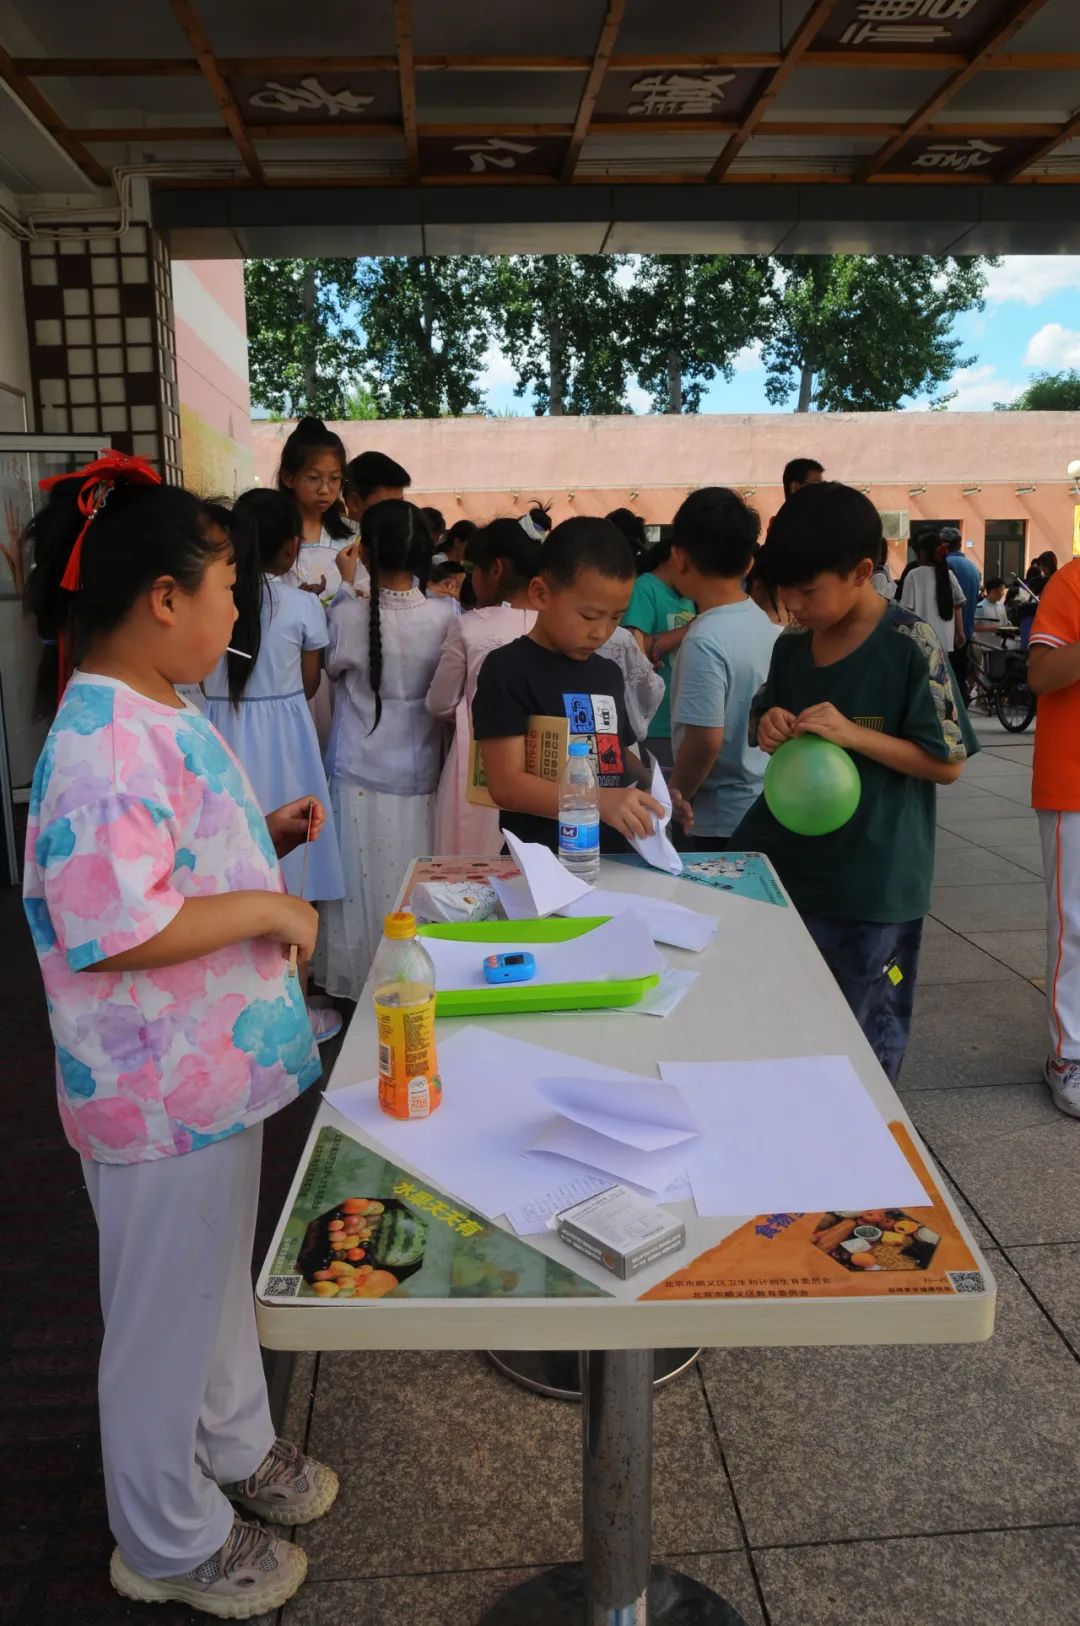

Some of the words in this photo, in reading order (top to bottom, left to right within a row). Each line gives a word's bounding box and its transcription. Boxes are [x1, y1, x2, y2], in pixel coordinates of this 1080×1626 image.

[248, 75, 374, 115] 孝
[627, 73, 736, 115] 誠
[452, 138, 537, 172] 仁
[911, 139, 1006, 170] 信
[393, 1182, 484, 1236] 水果天天有
[755, 1212, 805, 1239] 食物
